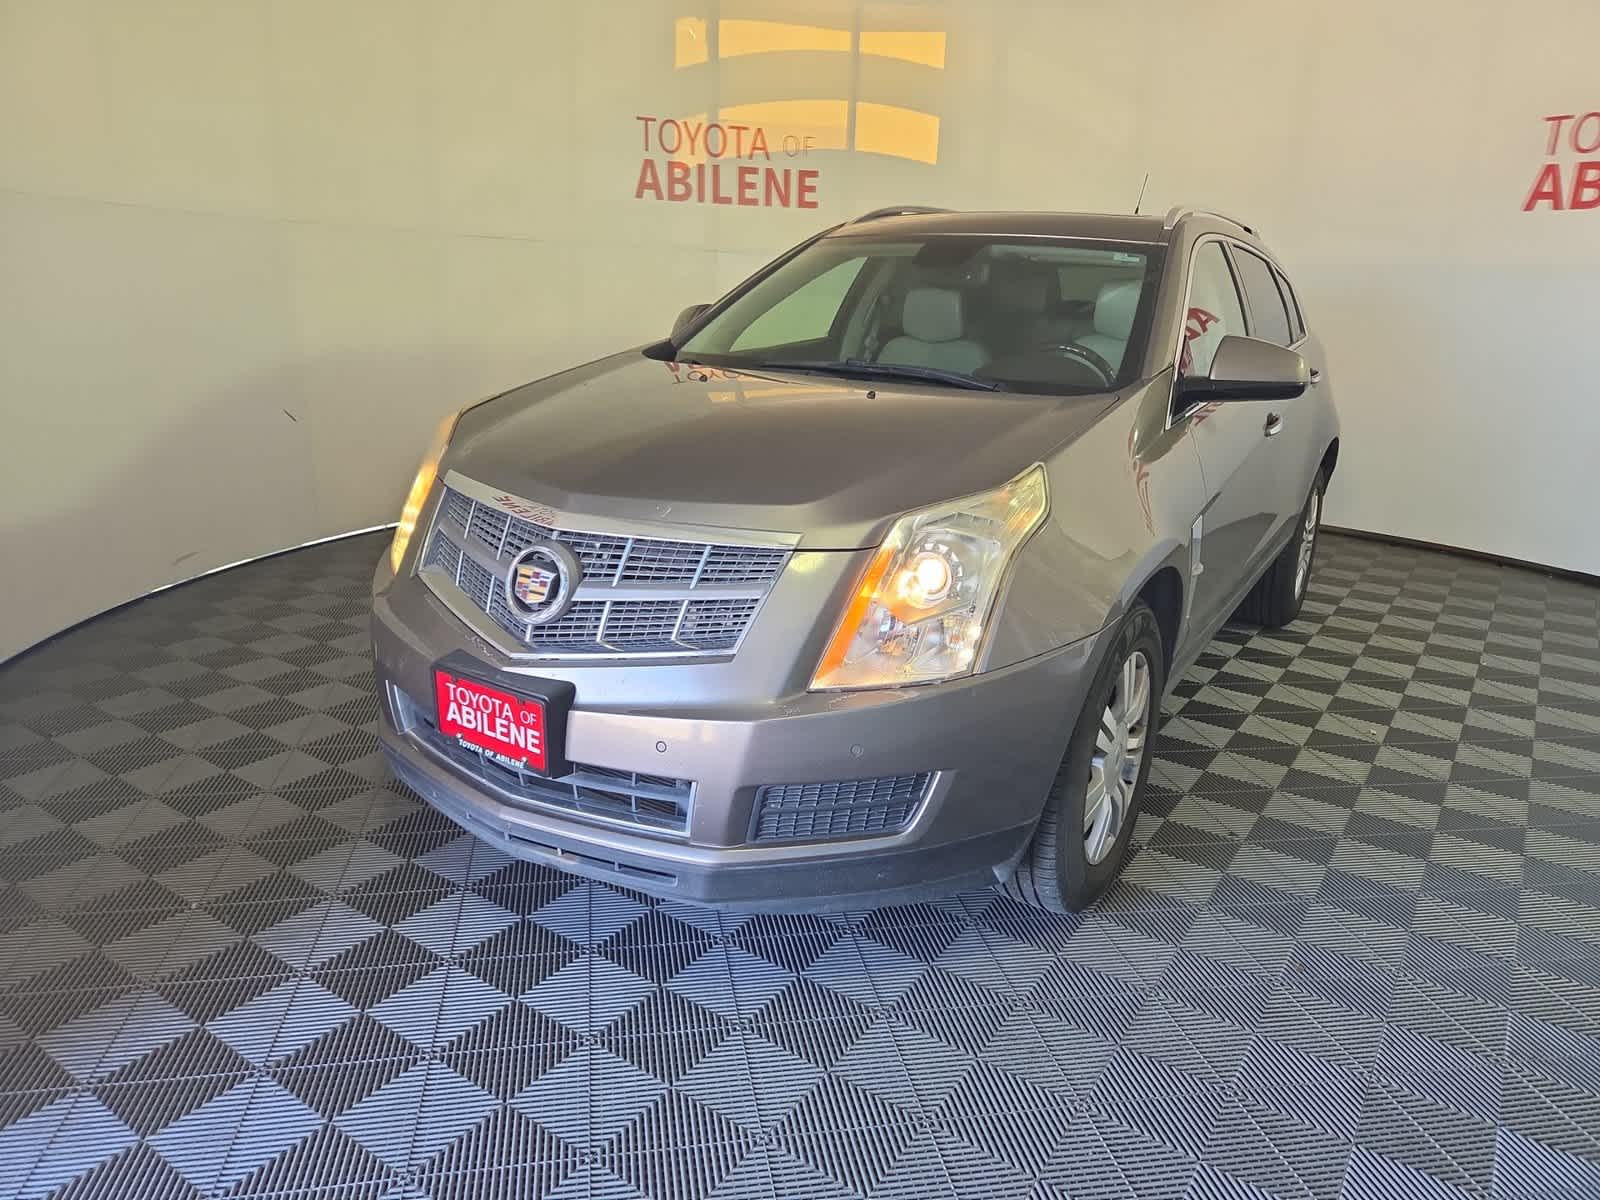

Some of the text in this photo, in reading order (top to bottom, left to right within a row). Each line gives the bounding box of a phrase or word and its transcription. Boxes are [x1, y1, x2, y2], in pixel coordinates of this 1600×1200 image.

[635, 115, 817, 161] TOYOTA OF
[634, 158, 820, 209] ABILENE
[445, 682, 537, 726] TOYOTA OF
[446, 701, 541, 755] ABILENE
[458, 739, 525, 769] TOYOTA OF ABILENE
